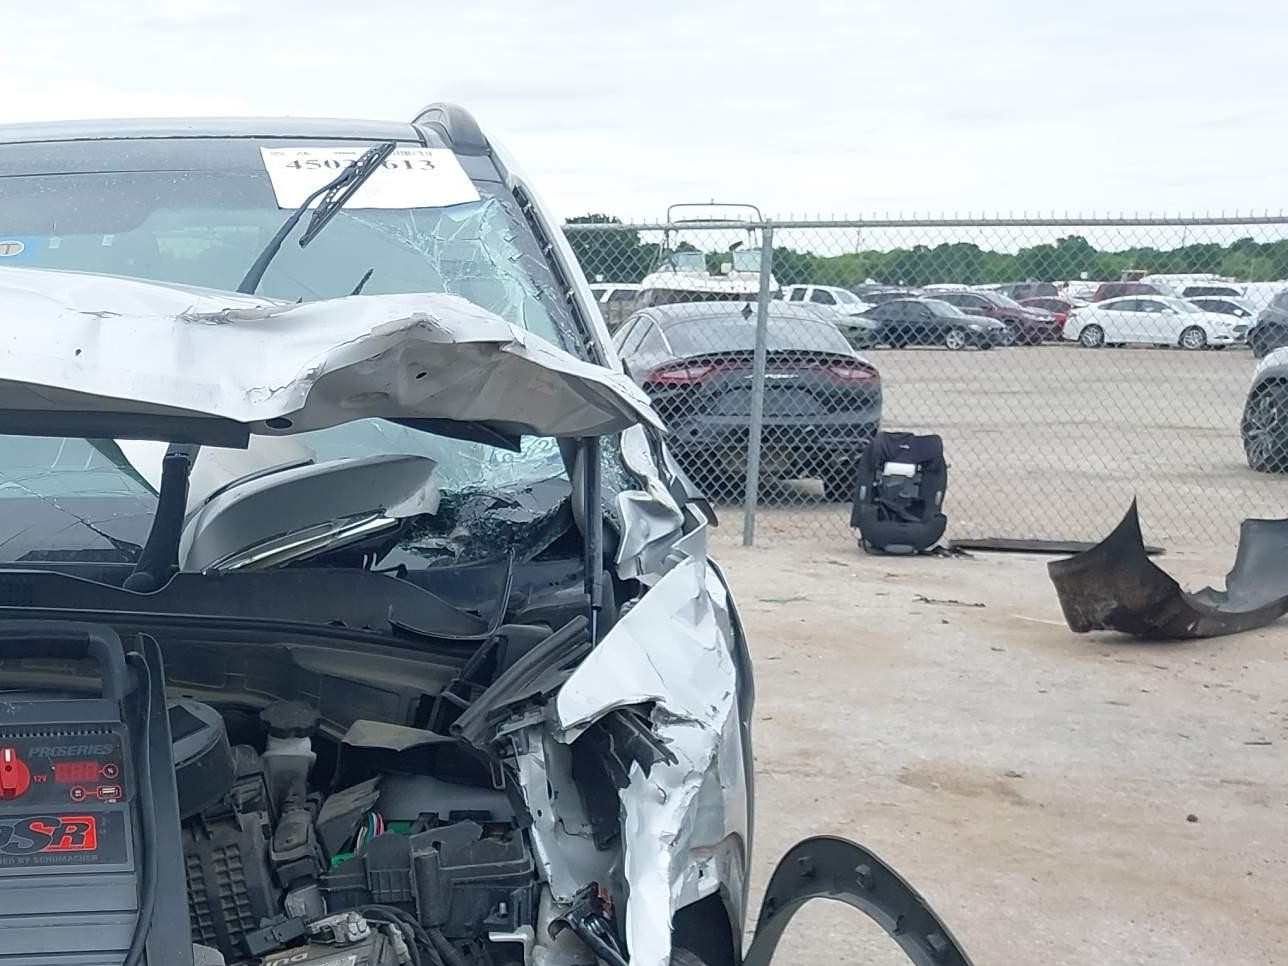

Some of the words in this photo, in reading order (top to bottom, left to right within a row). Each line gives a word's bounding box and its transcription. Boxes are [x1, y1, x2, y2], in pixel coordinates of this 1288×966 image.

[285, 159, 436, 171] 450613
[33, 775, 47, 783] 12V
[19, 857, 31, 865] BY
[34, 854, 99, 864] SCHUMACHER
